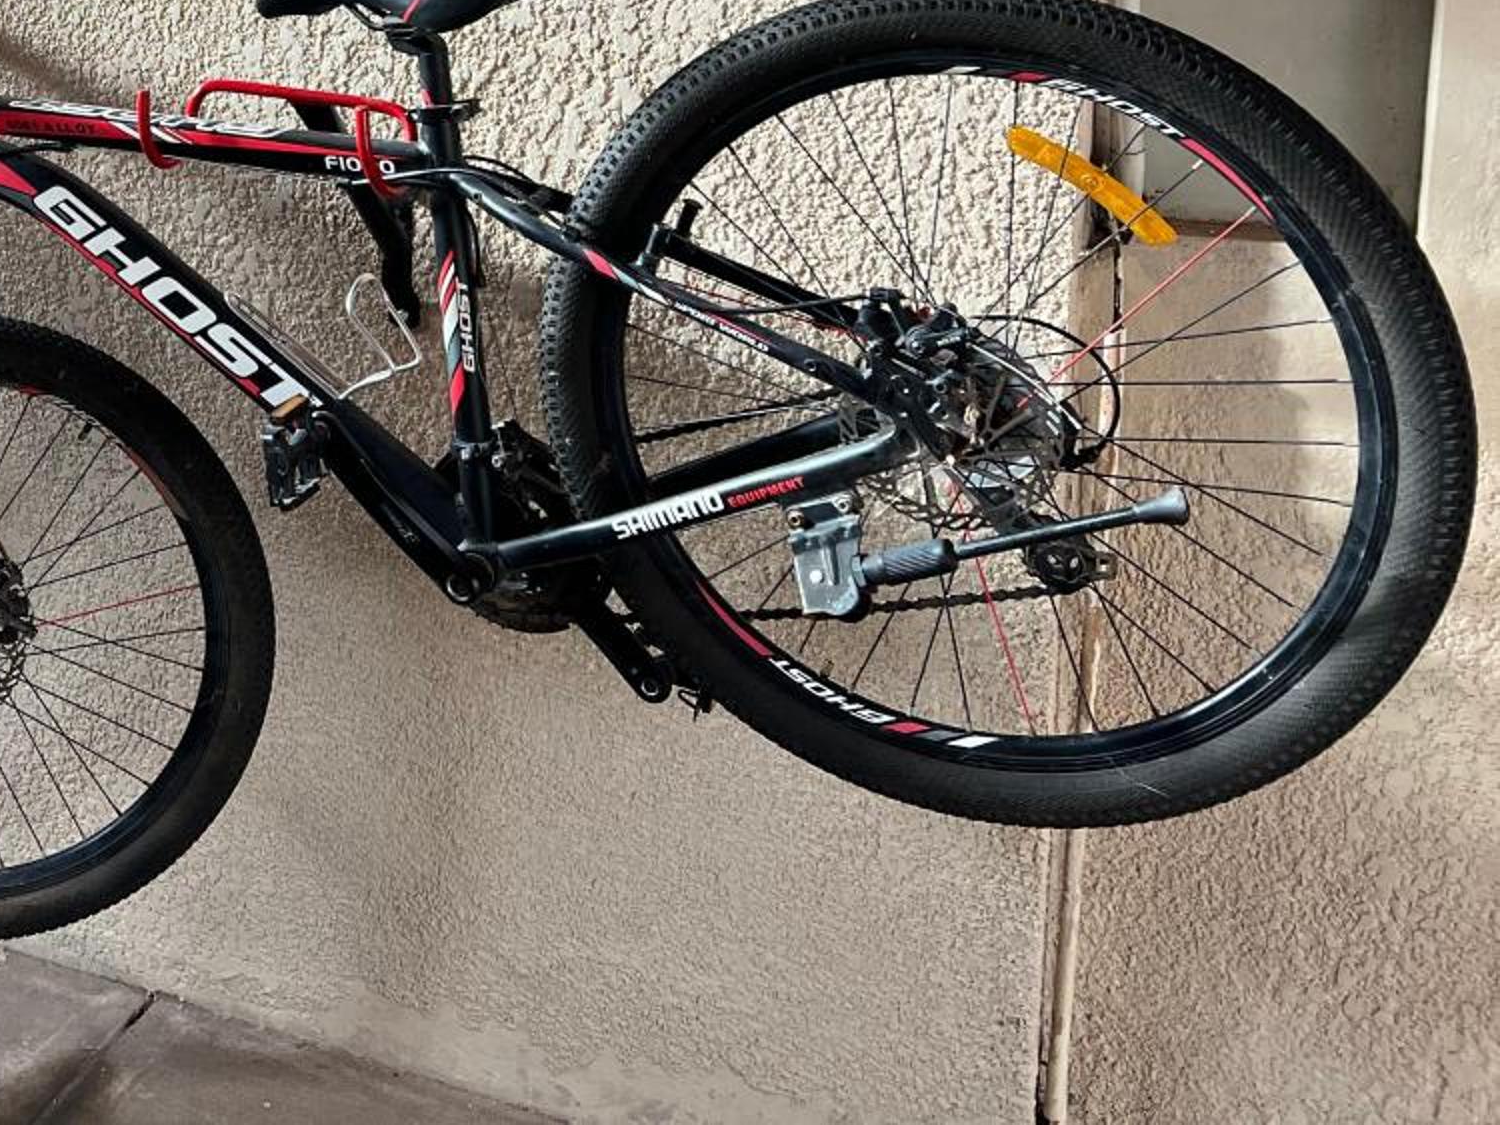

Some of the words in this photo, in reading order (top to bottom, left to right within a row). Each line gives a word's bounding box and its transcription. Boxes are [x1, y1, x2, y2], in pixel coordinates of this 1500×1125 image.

[33, 185, 309, 408] GHOST
[456, 275, 476, 373] GHOST
[727, 476, 805, 509] EQUIPMENT
[769, 658, 897, 724] GHOST
